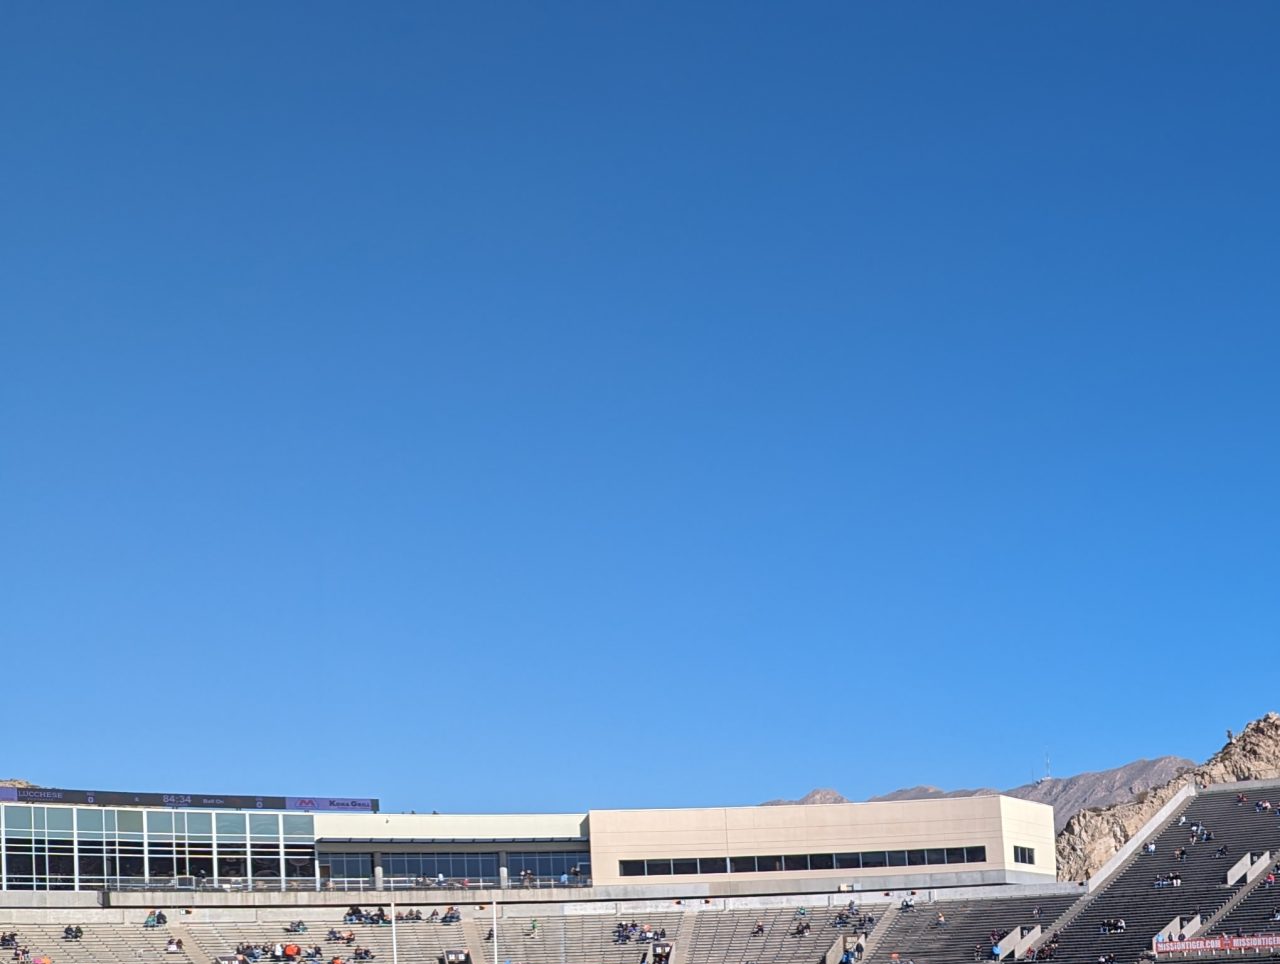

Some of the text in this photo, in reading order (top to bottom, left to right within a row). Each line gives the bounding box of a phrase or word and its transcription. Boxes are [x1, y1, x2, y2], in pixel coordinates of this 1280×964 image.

[18, 790, 63, 799] LUCCHESE
[163, 794, 192, 804] 84:34
[1158, 939, 1221, 951] MISSIONTIGER.COM
